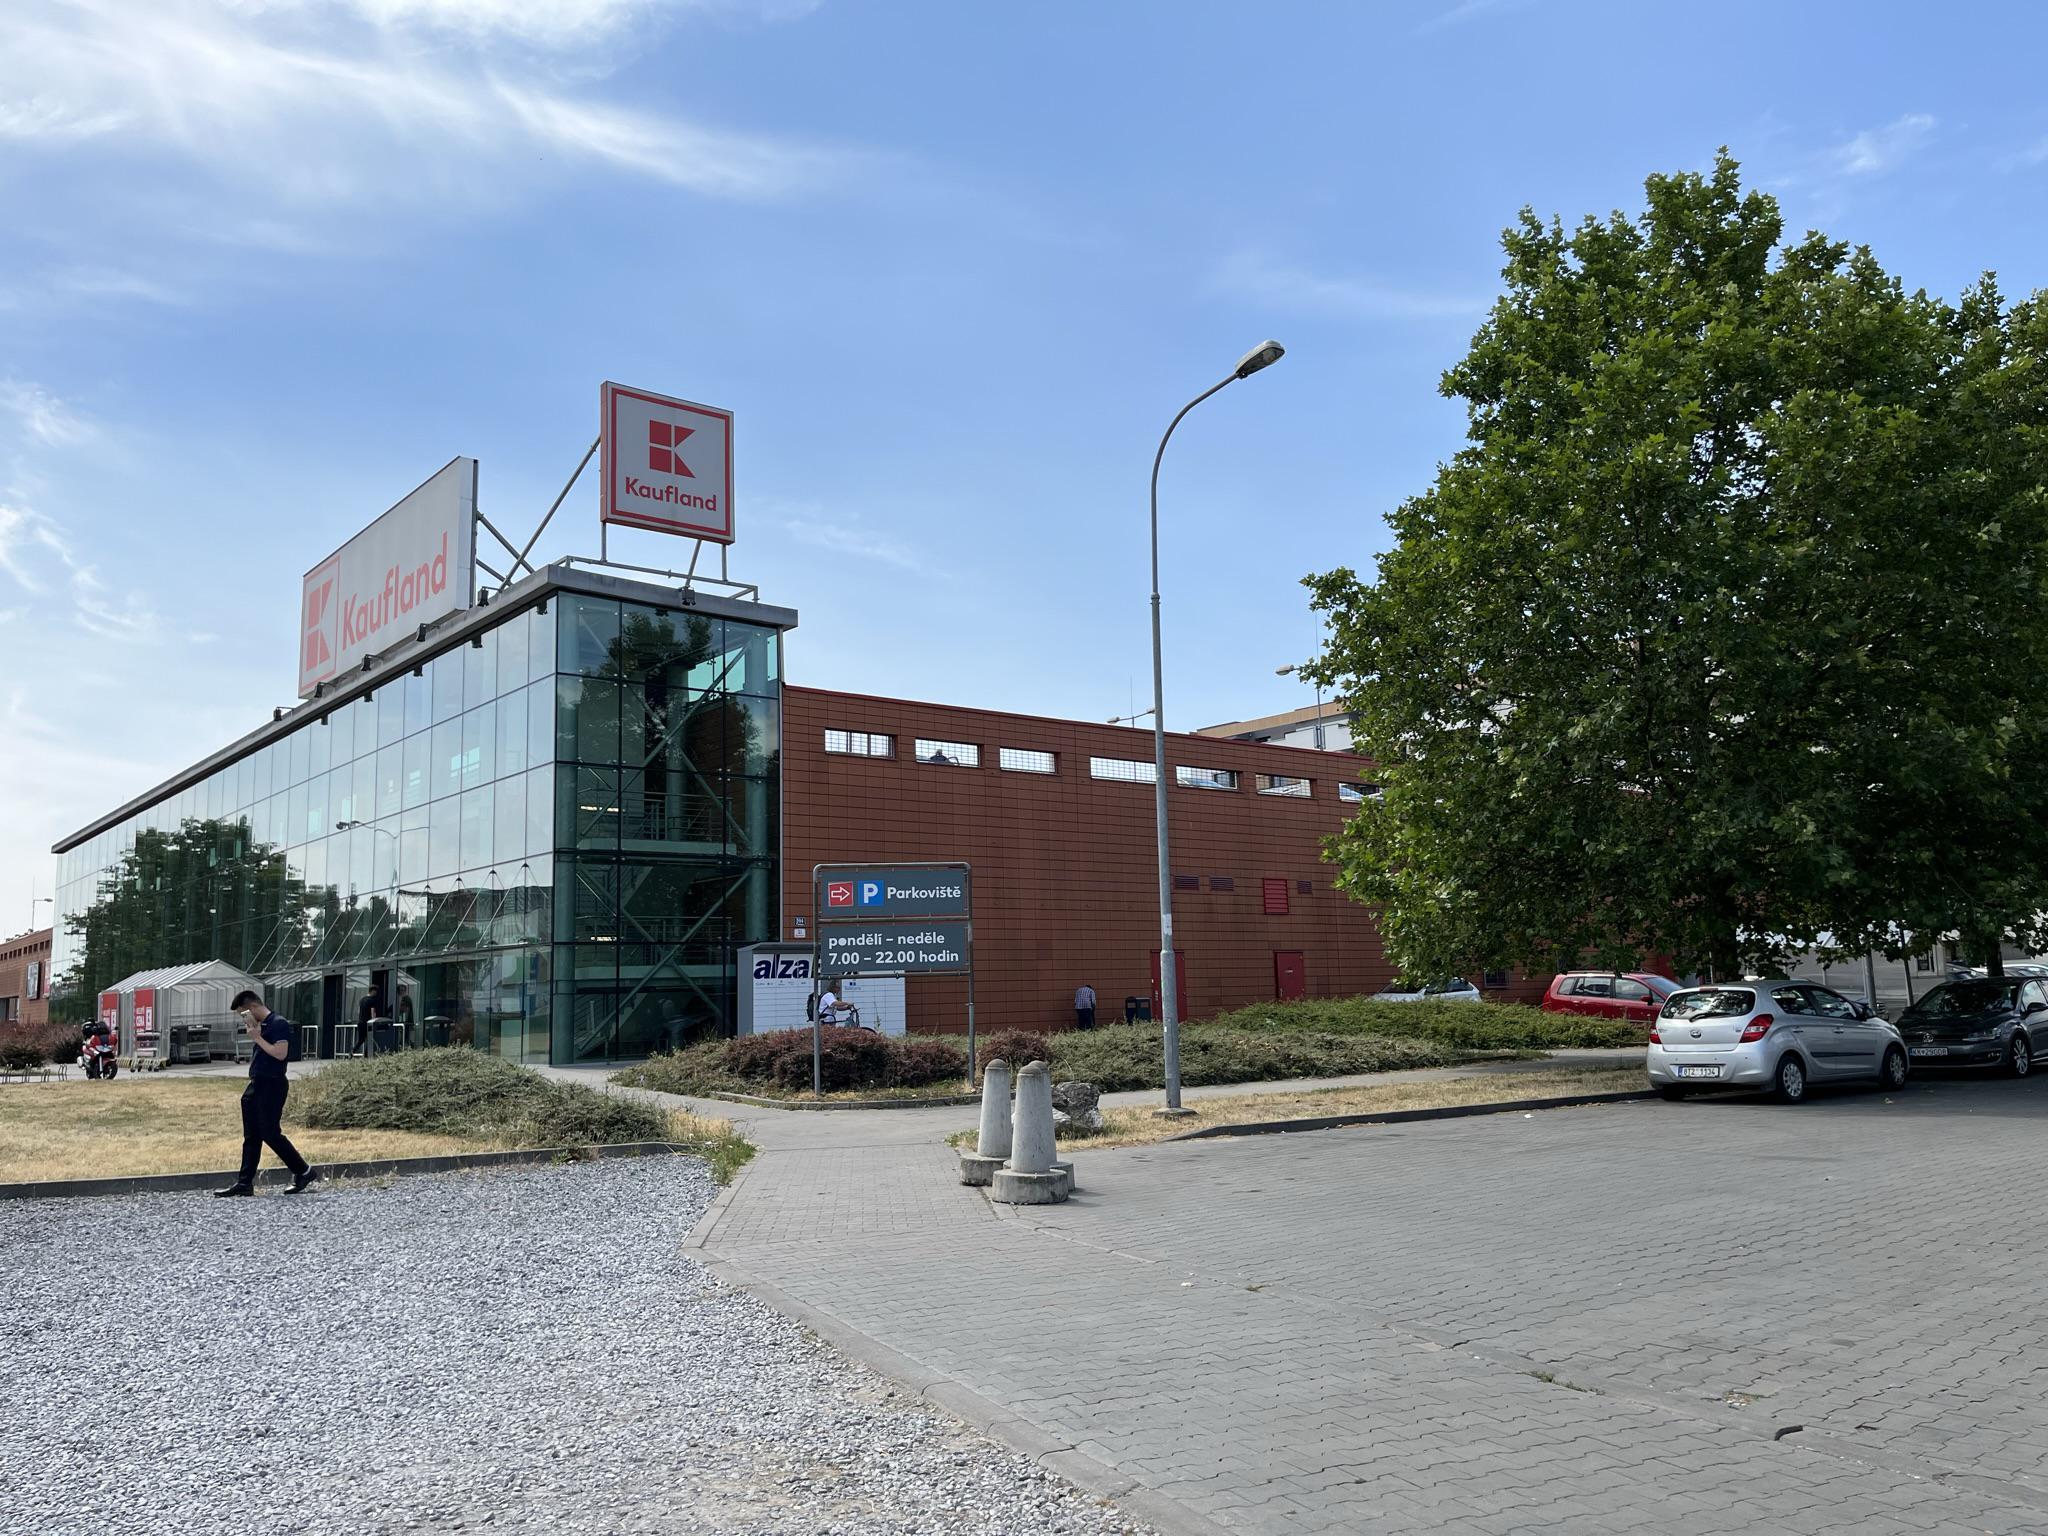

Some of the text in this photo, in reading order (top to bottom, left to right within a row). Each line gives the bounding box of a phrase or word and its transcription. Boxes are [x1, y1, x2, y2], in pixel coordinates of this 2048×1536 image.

[625, 476, 717, 512] Kaufland
[342, 530, 448, 652] Kaufland
[863, 883, 961, 904] P Parkoviště
[828, 933, 883, 950] pondělí
[897, 931, 945, 945] neděle
[828, 952, 860, 965] 7.00
[875, 950, 916, 964] 22.00
[919, 950, 959, 963] hodin
